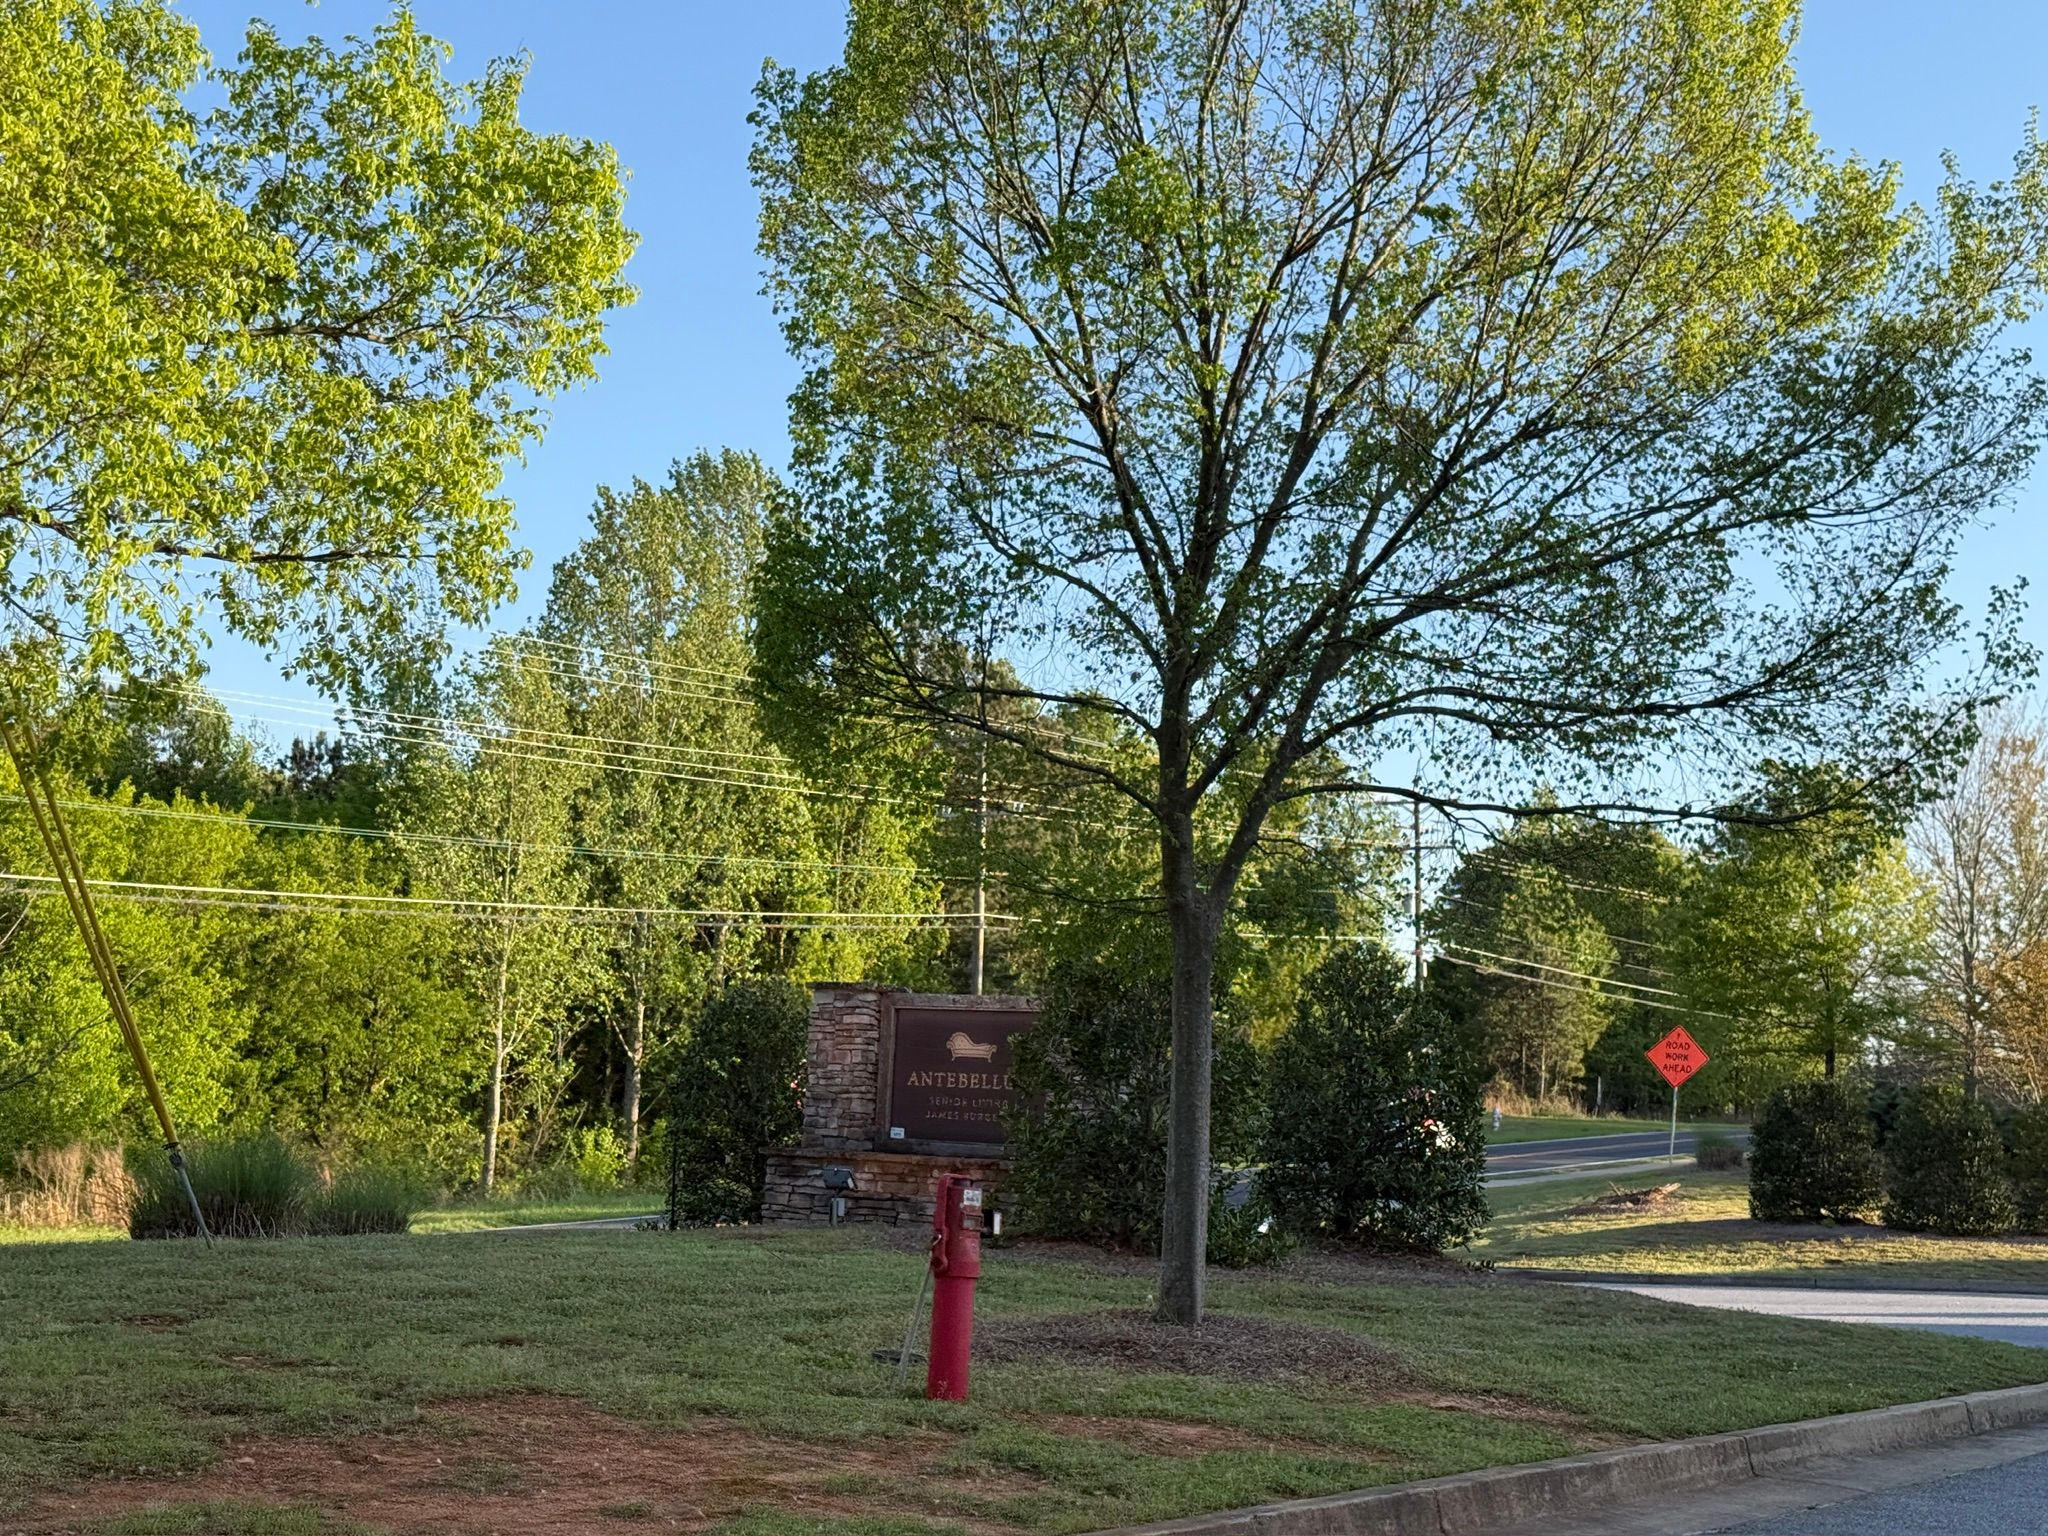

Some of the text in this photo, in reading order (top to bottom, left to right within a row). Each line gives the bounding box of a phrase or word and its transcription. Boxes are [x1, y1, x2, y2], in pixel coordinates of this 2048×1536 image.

[1665, 1041, 1690, 1051] ROAD
[1665, 1052, 1689, 1062] WORK
[1662, 1063, 1692, 1074] AHEAD
[907, 1071, 1014, 1090] ANTEBELLU
[925, 1110, 959, 1120] JAMES
